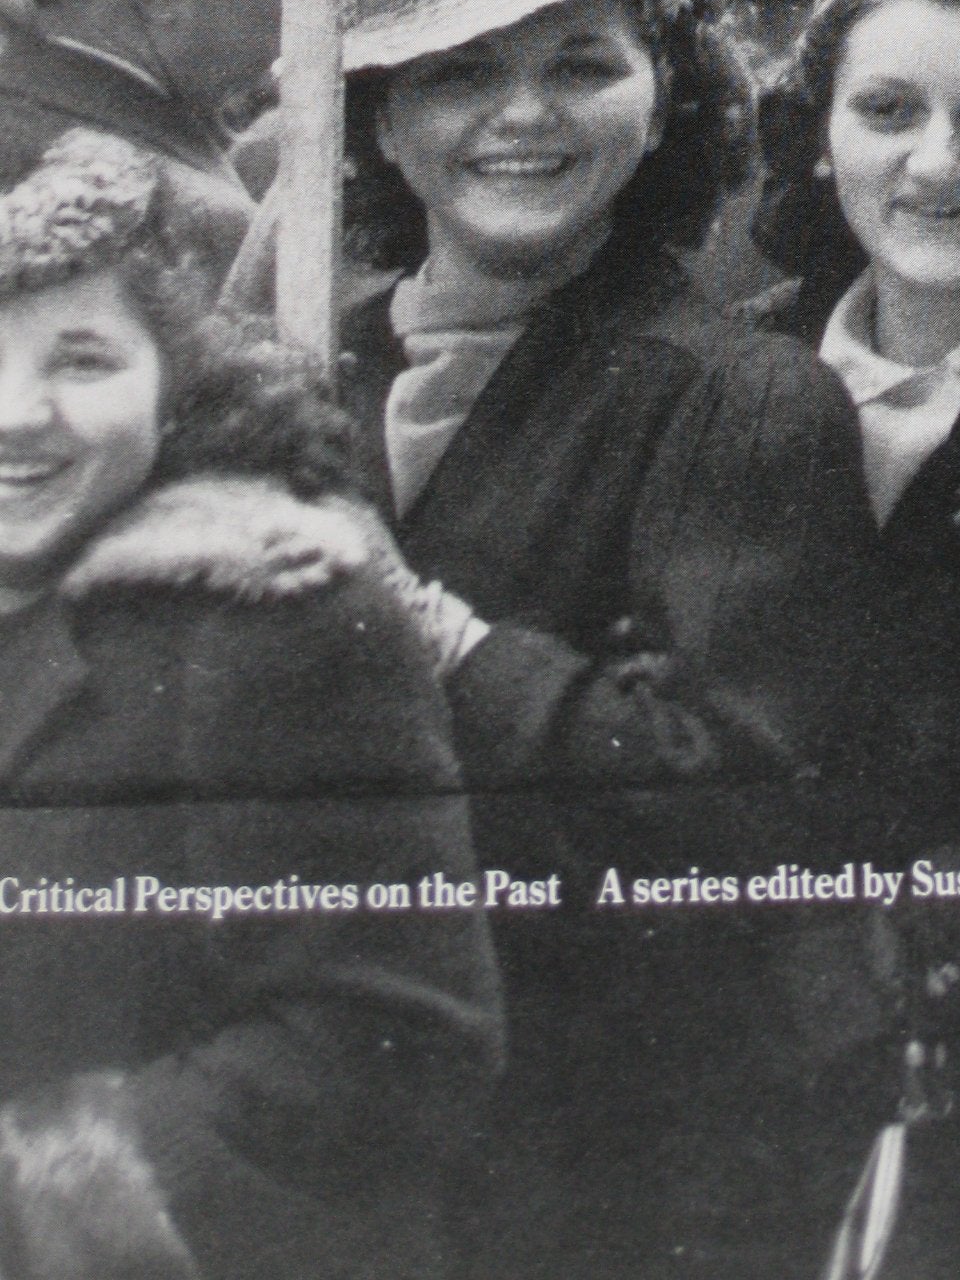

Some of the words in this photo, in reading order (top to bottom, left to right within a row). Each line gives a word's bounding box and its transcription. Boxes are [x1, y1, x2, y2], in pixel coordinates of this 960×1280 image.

[0, 877, 125, 913] Critical
[134, 875, 358, 919] Perspectives
[366, 882, 411, 909] on
[418, 872, 476, 908] the
[483, 869, 562, 906] Past
[597, 867, 625, 904] A
[632, 866, 739, 903] series
[747, 863, 856, 901] edited
[863, 862, 903, 905] by
